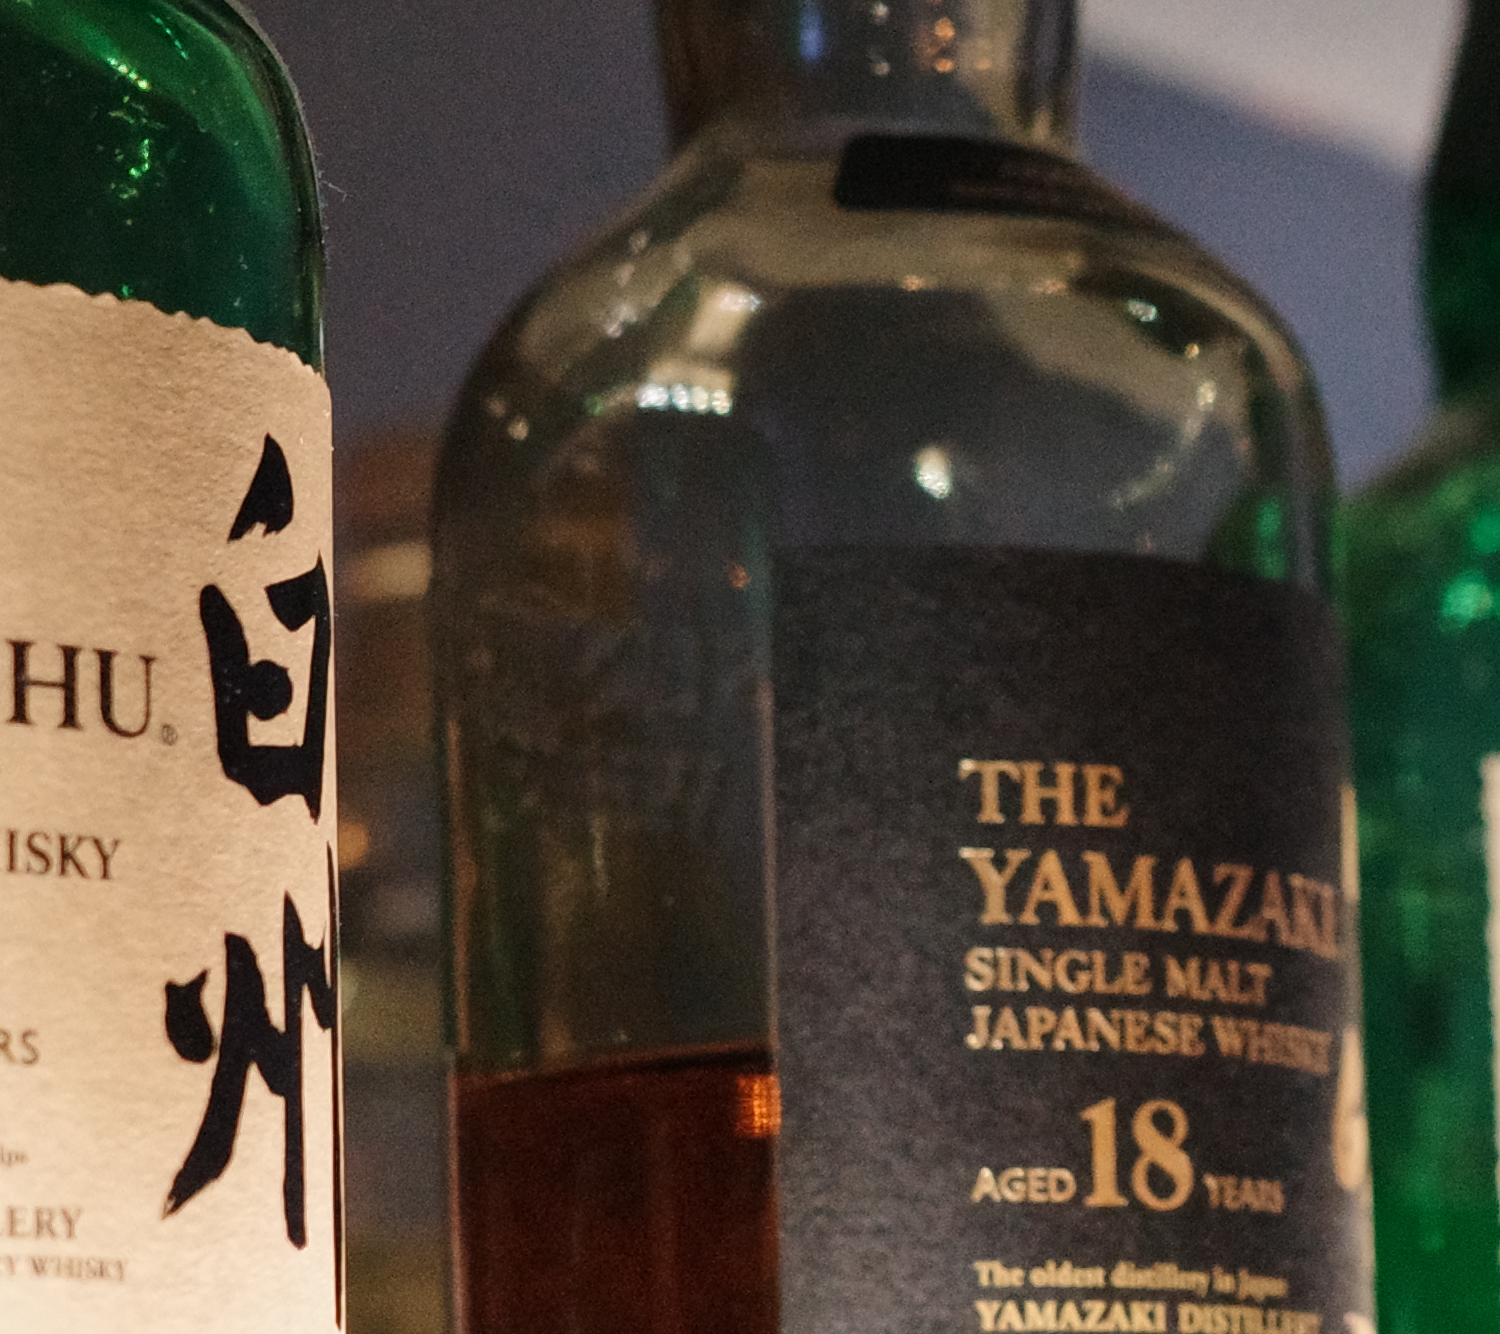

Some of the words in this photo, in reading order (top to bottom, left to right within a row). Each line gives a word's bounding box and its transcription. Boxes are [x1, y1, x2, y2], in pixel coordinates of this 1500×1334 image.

[958, 758, 1131, 828] THE
[958, 846, 1338, 960] YAMAZAKI
[963, 945, 1153, 996] SINGLE
[1164, 954, 1273, 1004] MALT
[965, 1004, 1206, 1057] JAPANESE
[970, 1165, 1077, 1203] AGED
[1079, 1097, 1195, 1211] 18
[1202, 1172, 1286, 1215] YEARS
[28, 1253, 129, 1283] WHISKY
[973, 1259, 1025, 1288] The
[1213, 1264, 1236, 1294] in
[974, 1299, 1167, 1333] YAMAZAKI
